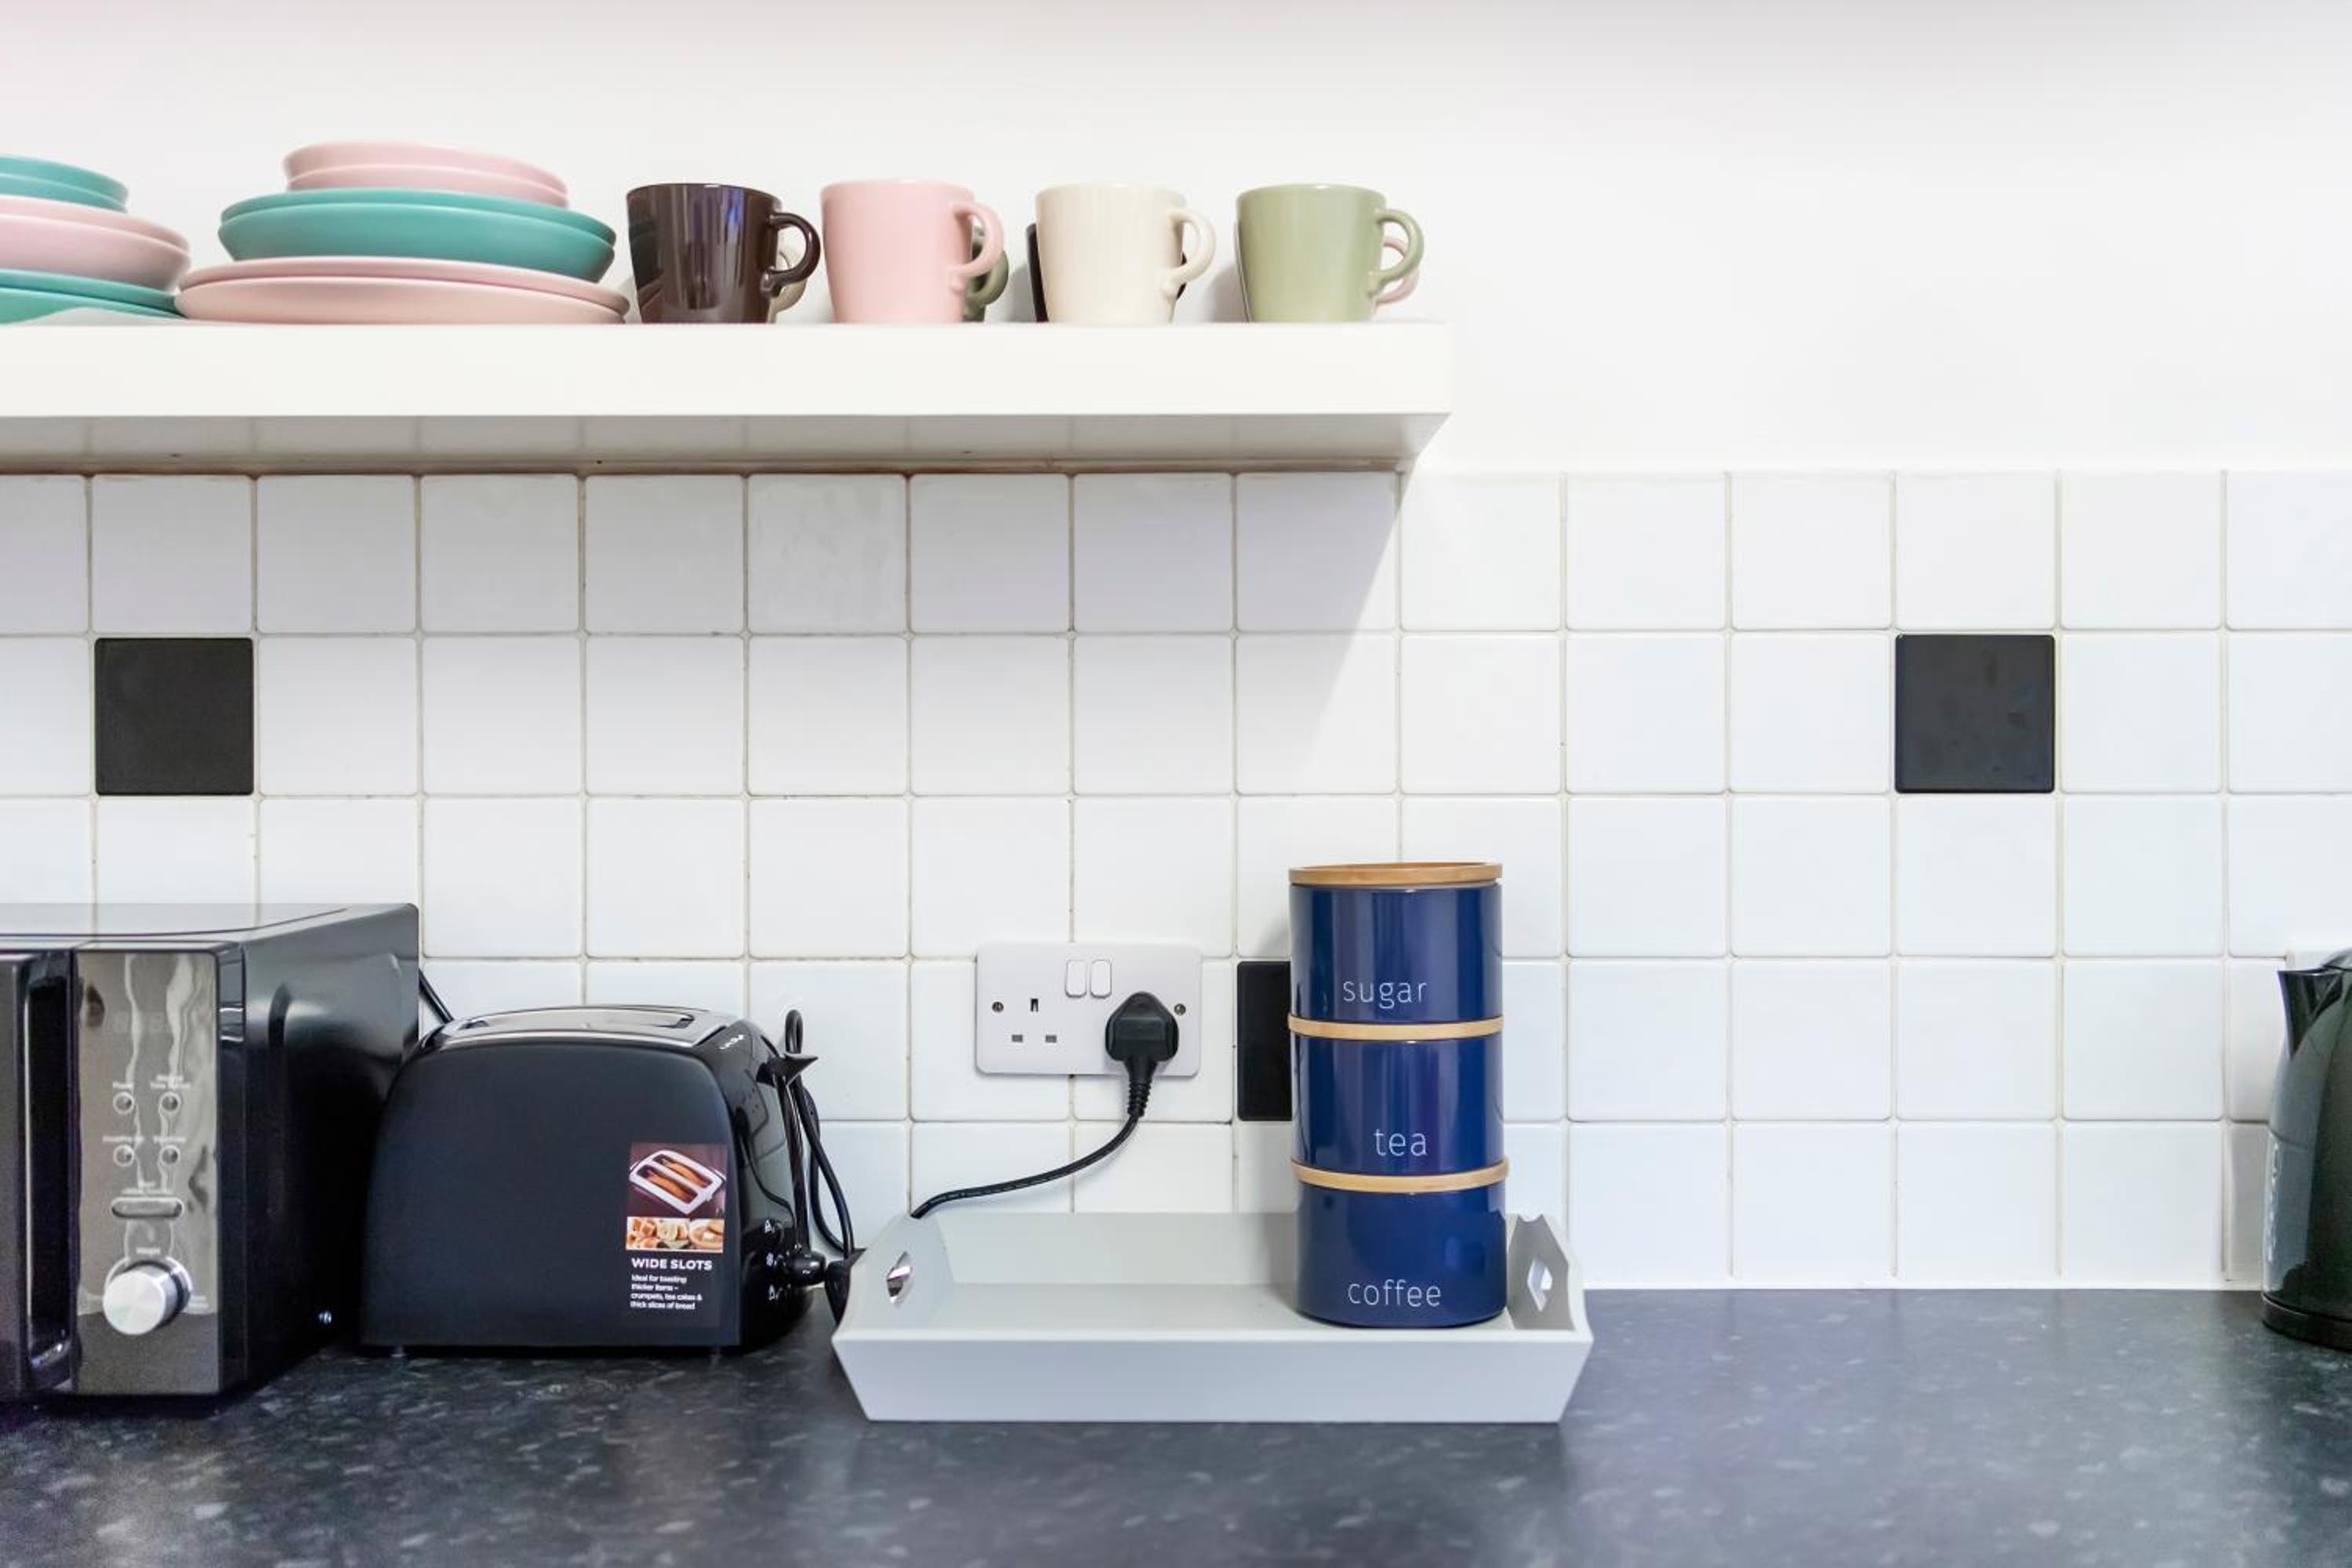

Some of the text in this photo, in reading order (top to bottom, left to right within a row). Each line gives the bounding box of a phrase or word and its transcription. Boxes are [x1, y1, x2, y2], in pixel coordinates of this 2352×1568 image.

[1342, 979, 1428, 1009] sugar
[1374, 1127, 1428, 1156] tea
[631, 1258, 713, 1270] WIDE SLOTS
[1347, 1279, 1442, 1307] coffee
